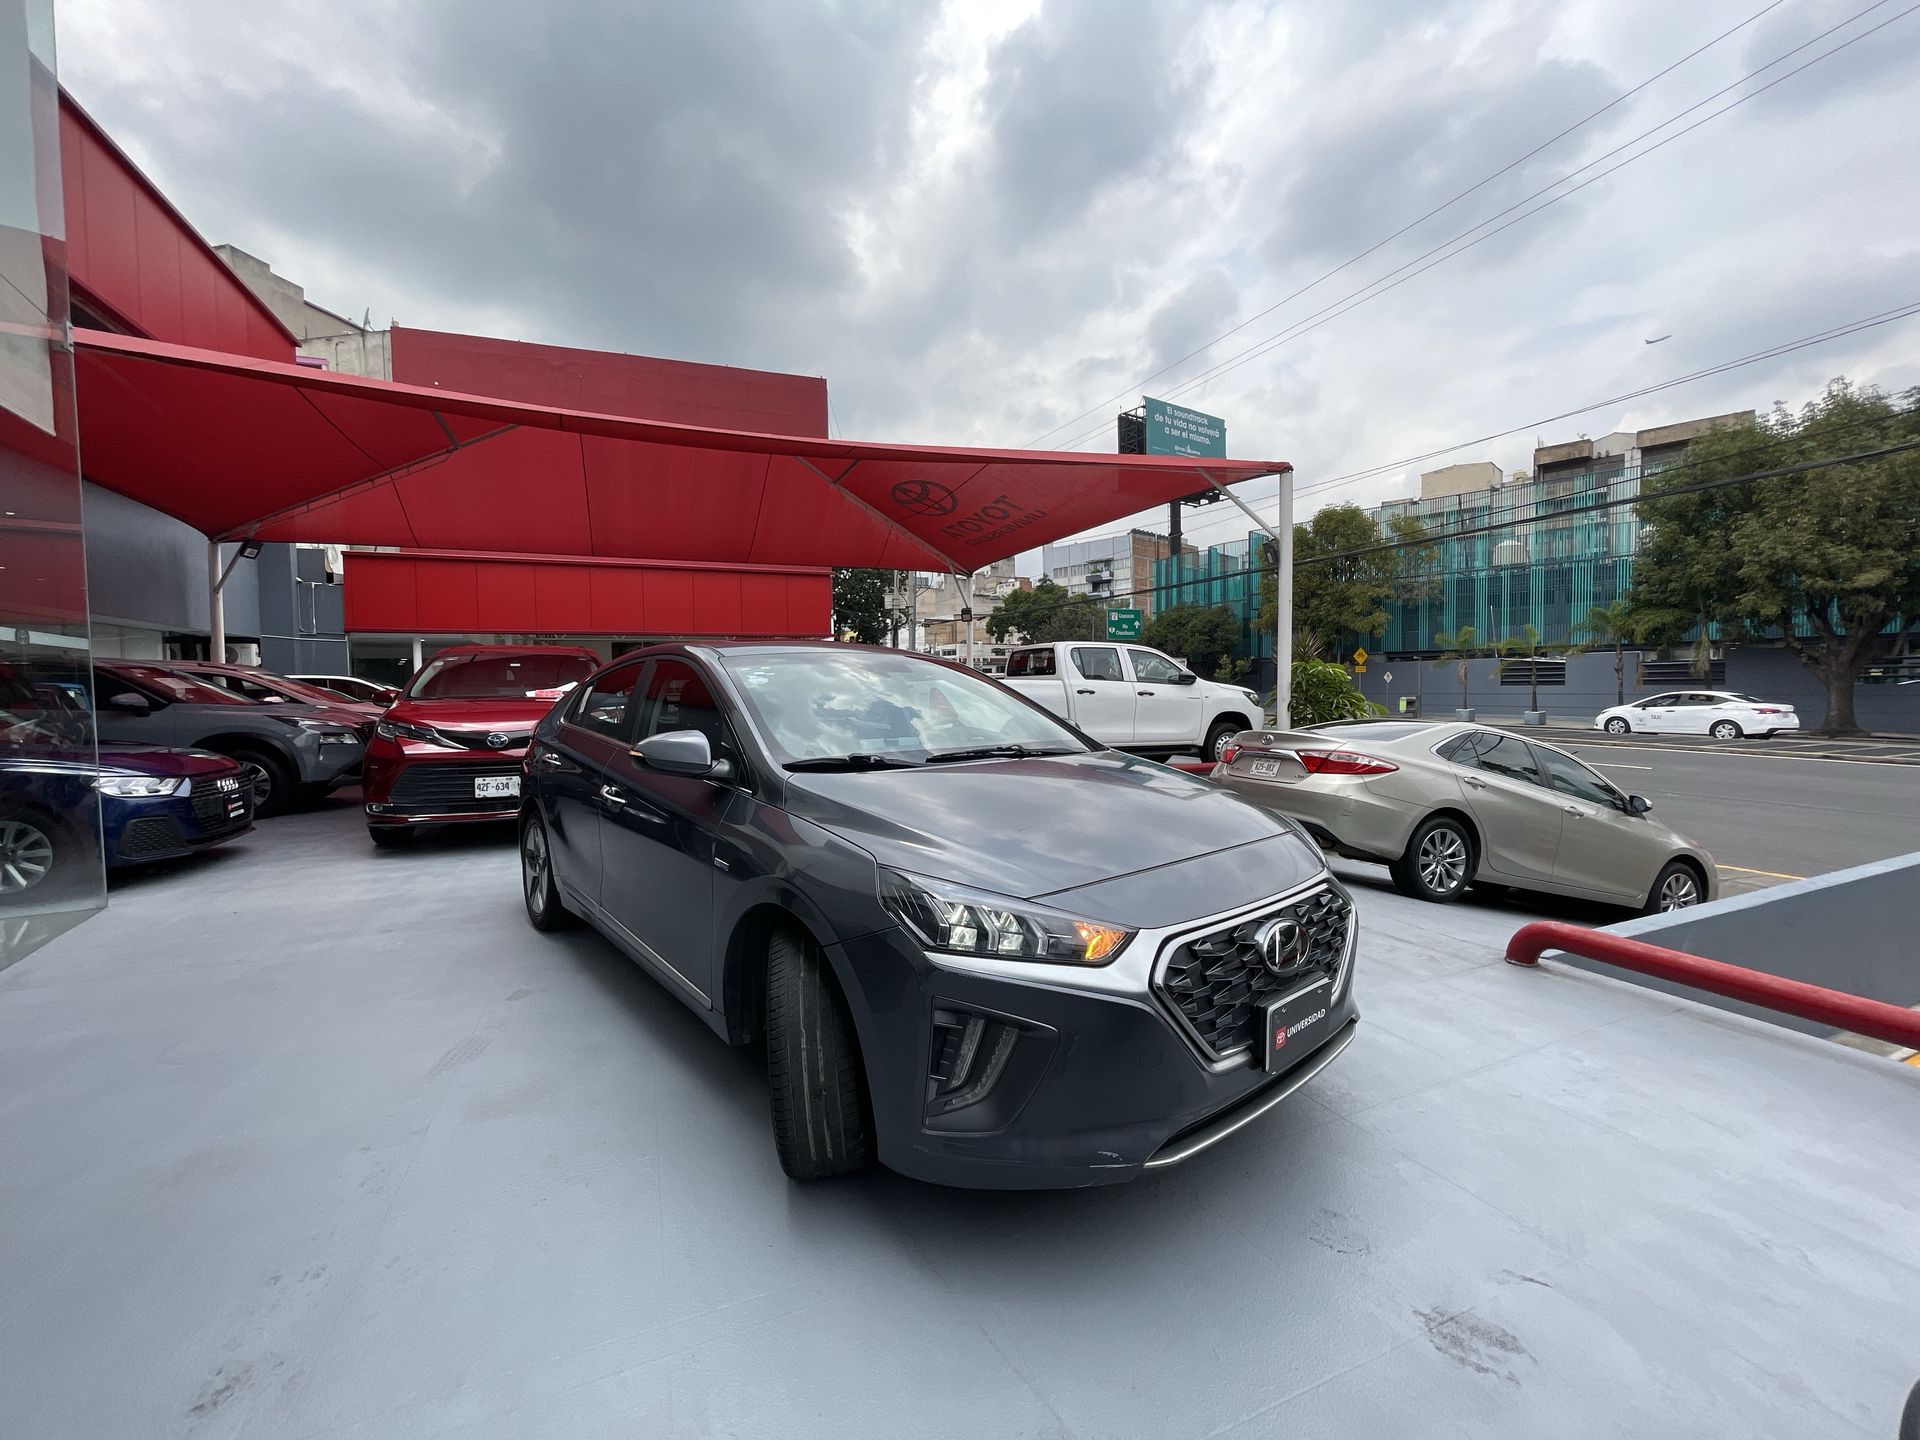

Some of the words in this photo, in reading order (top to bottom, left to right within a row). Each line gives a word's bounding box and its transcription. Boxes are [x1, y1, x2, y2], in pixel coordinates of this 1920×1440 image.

[1154, 413, 1164, 423] de
[1165, 415, 1172, 425] tu
[1172, 417, 1188, 429] vida
[1188, 422, 1197, 432] no
[1197, 424, 1220, 438] volverá
[1166, 406, 1173, 415] El
[1173, 409, 1209, 426] soundtrack
[1171, 427, 1181, 437] ser
[1181, 430, 1188, 439] el
[1189, 432, 1212, 445] mismo.
[1286, 1008, 1326, 1038] UNIVERSIDAD
